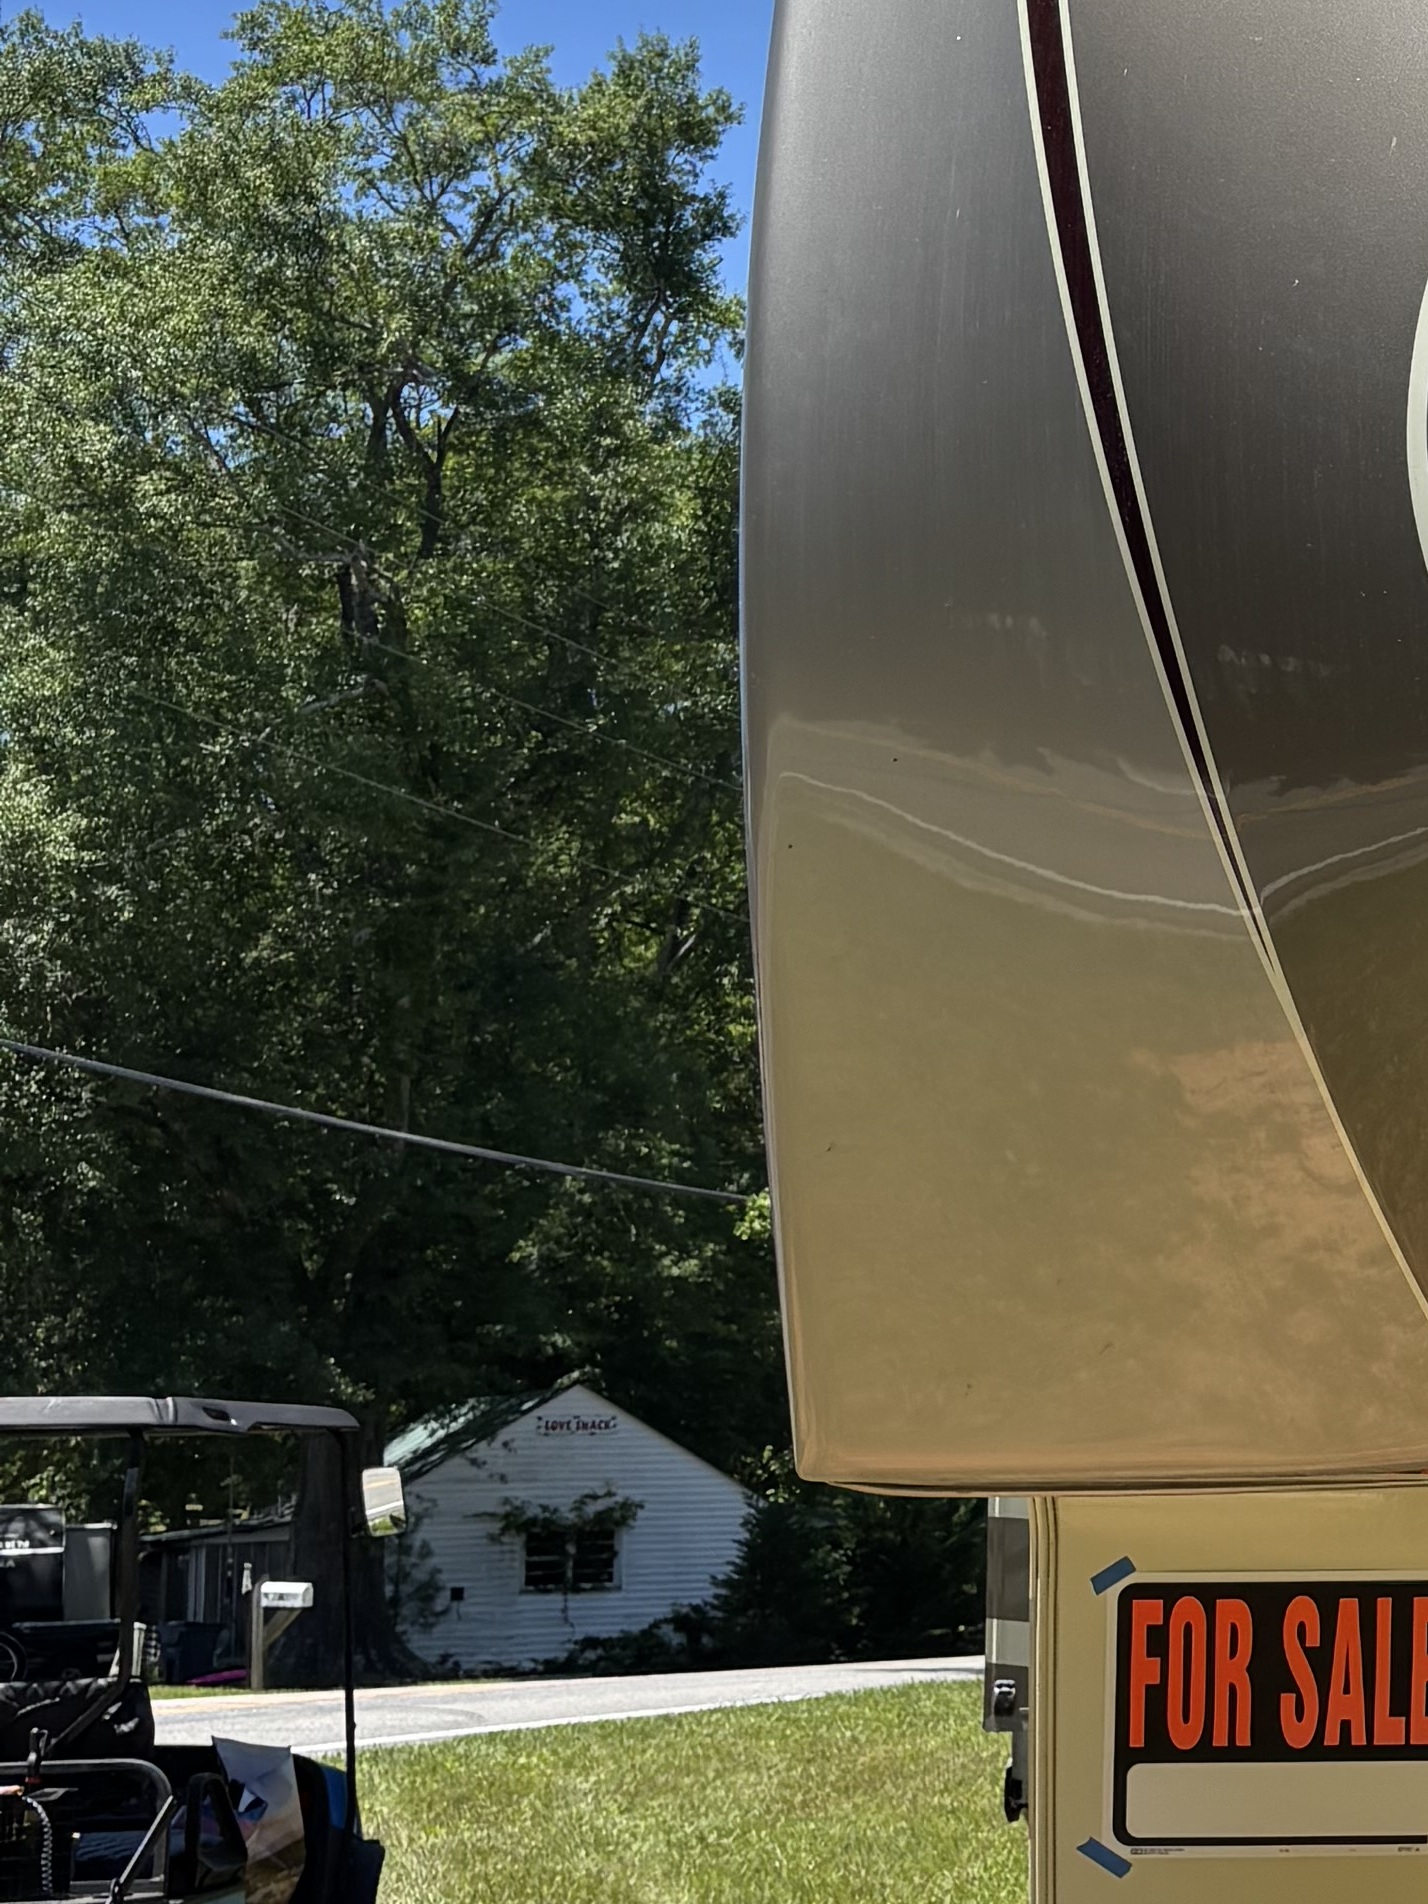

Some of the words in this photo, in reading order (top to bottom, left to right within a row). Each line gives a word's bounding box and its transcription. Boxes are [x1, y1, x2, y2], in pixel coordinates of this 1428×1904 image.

[544, 1419, 571, 1431] LOVE
[575, 1419, 611, 1431] SHACK
[1128, 1595, 1253, 1751] FOR
